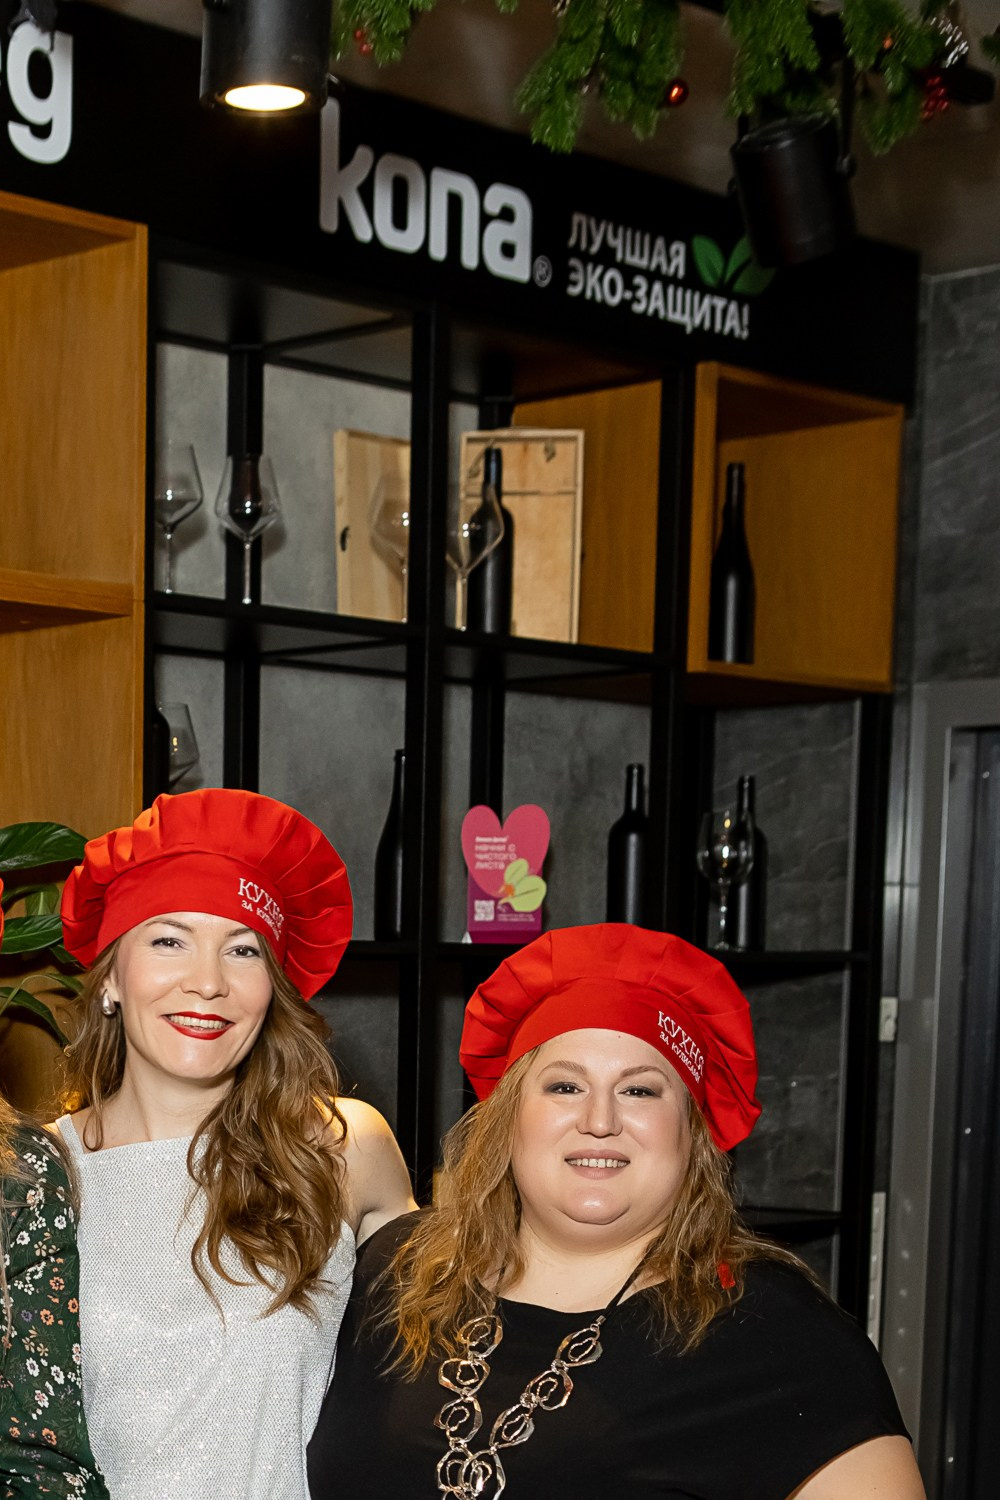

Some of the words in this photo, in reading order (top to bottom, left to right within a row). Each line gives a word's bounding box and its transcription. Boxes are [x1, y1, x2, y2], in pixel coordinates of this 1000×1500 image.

[319, 96, 534, 285] kona
[567, 211, 688, 279] ЛУЧШАЯ
[566, 258, 751, 341] ЭКО-ЗАЩИТА!
[657, 1010, 705, 1077] КУХНЯ
[659, 1031, 670, 1046] ЗА
